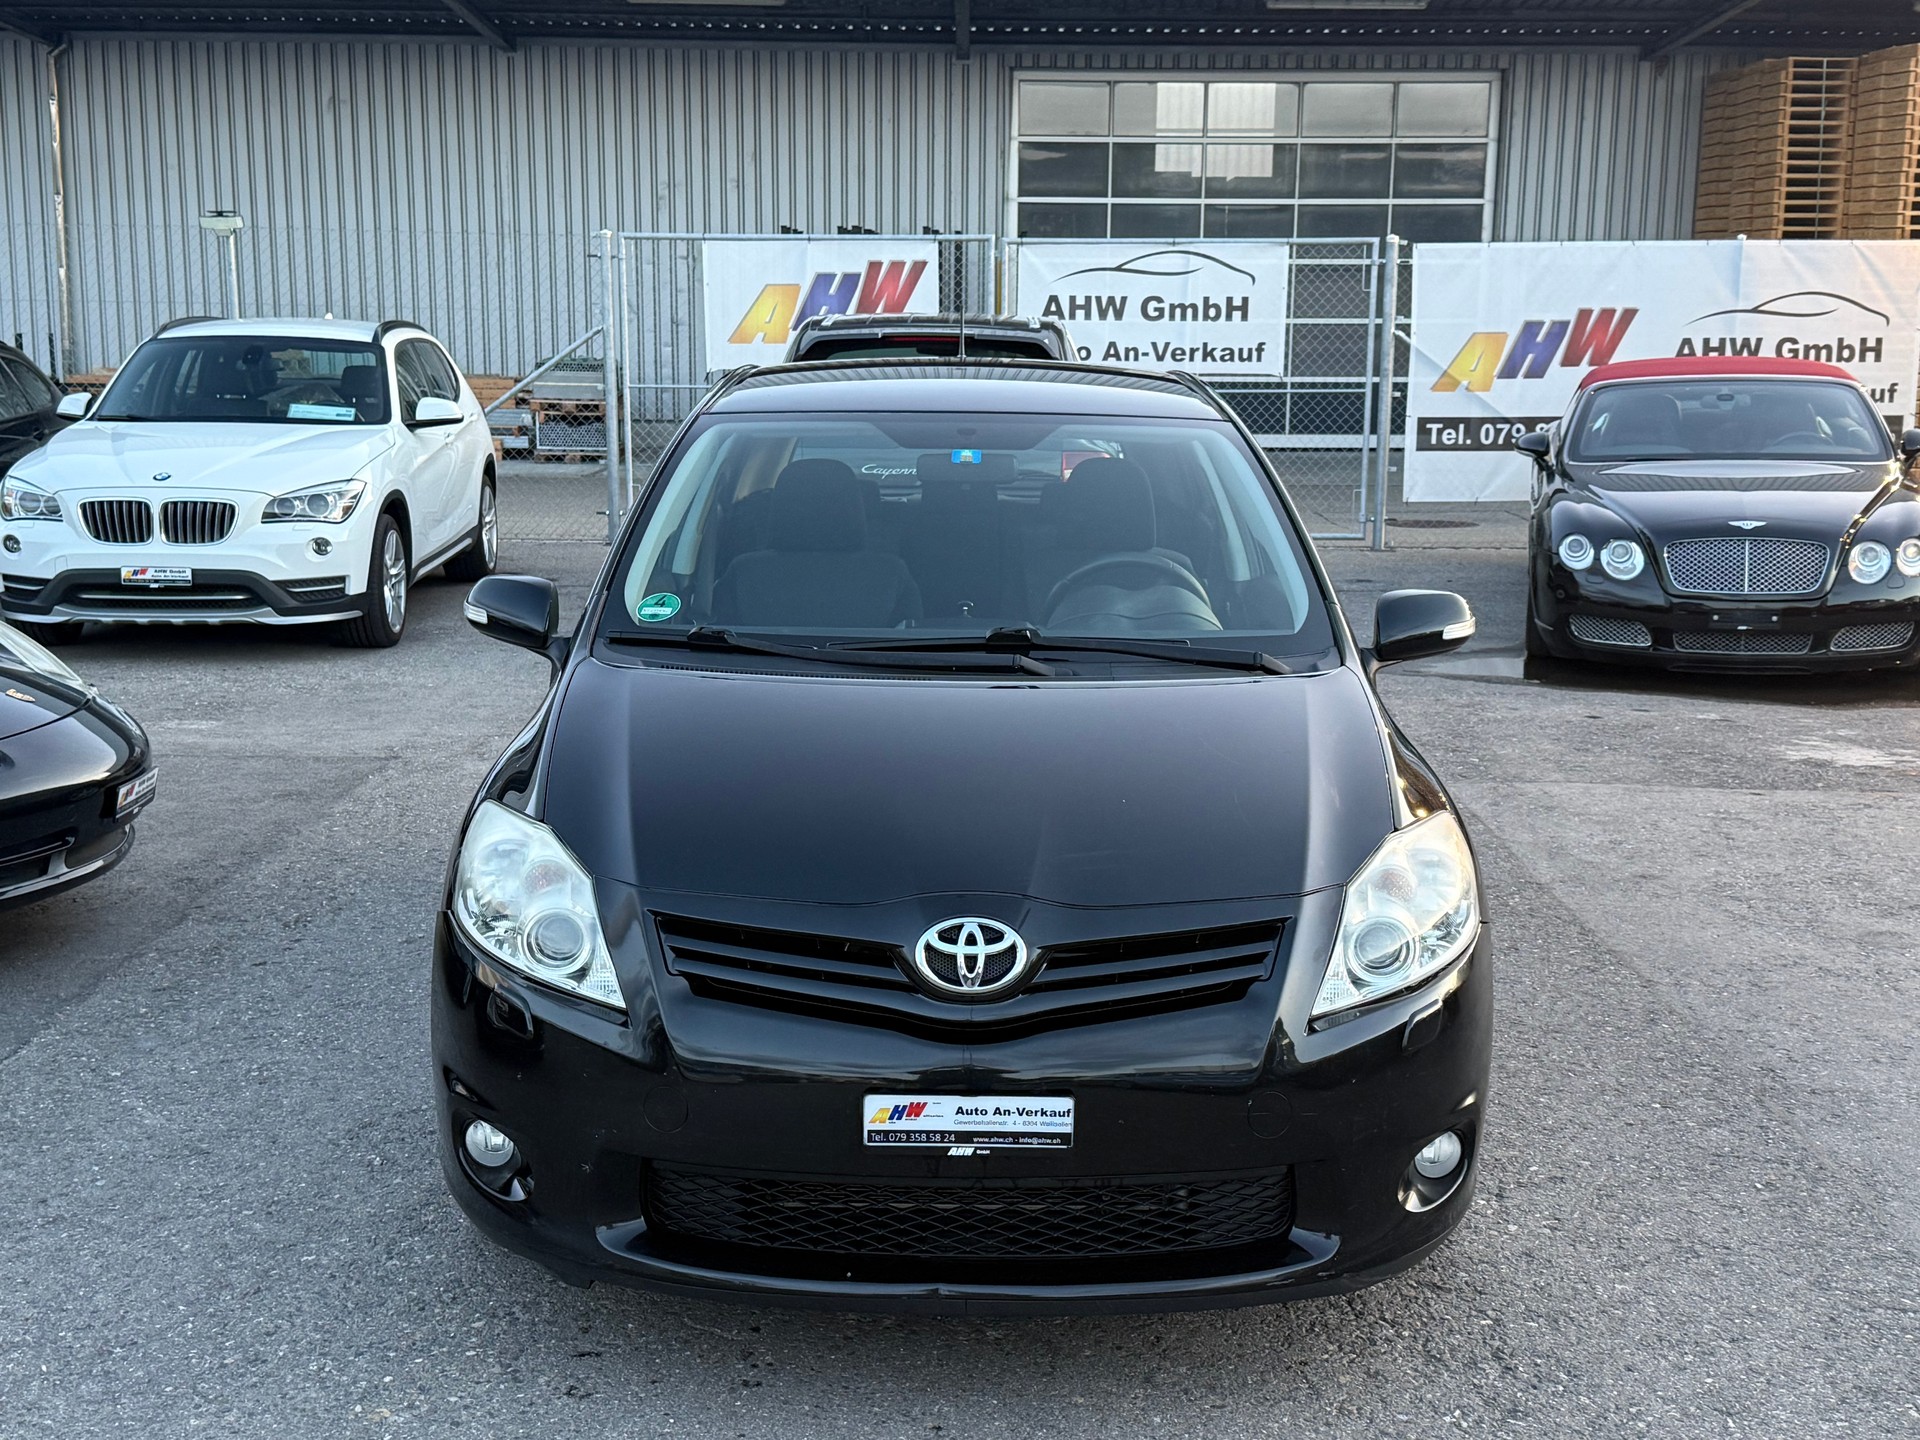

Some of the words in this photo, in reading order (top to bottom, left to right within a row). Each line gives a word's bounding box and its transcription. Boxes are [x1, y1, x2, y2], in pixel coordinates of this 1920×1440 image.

[727, 259, 928, 344] AHW
[1042, 295, 1128, 321] AHW
[1140, 296, 1249, 322] GmbH
[1102, 341, 1266, 363] An-Verkauf
[1430, 308, 1640, 392] AHW
[1675, 337, 1763, 357] AHW
[1775, 337, 1884, 363] GmbH
[1426, 423, 1471, 445] Tel.
[1480, 423, 1526, 445] 079
[861, 464, 917, 479] Cayenn
[654, 595, 667, 607] 4
[869, 1102, 928, 1124] AHW
[955, 1106, 988, 1116] Auto
[993, 1107, 1072, 1118] An-Verkauf
[871, 1133, 886, 1141] Tel.
[888, 1133, 907, 1142] 079
[909, 1133, 927, 1142] 358
[929, 1133, 941, 1142] 58
[943, 1133, 955, 1142] 24
[947, 1147, 975, 1156] AHW
